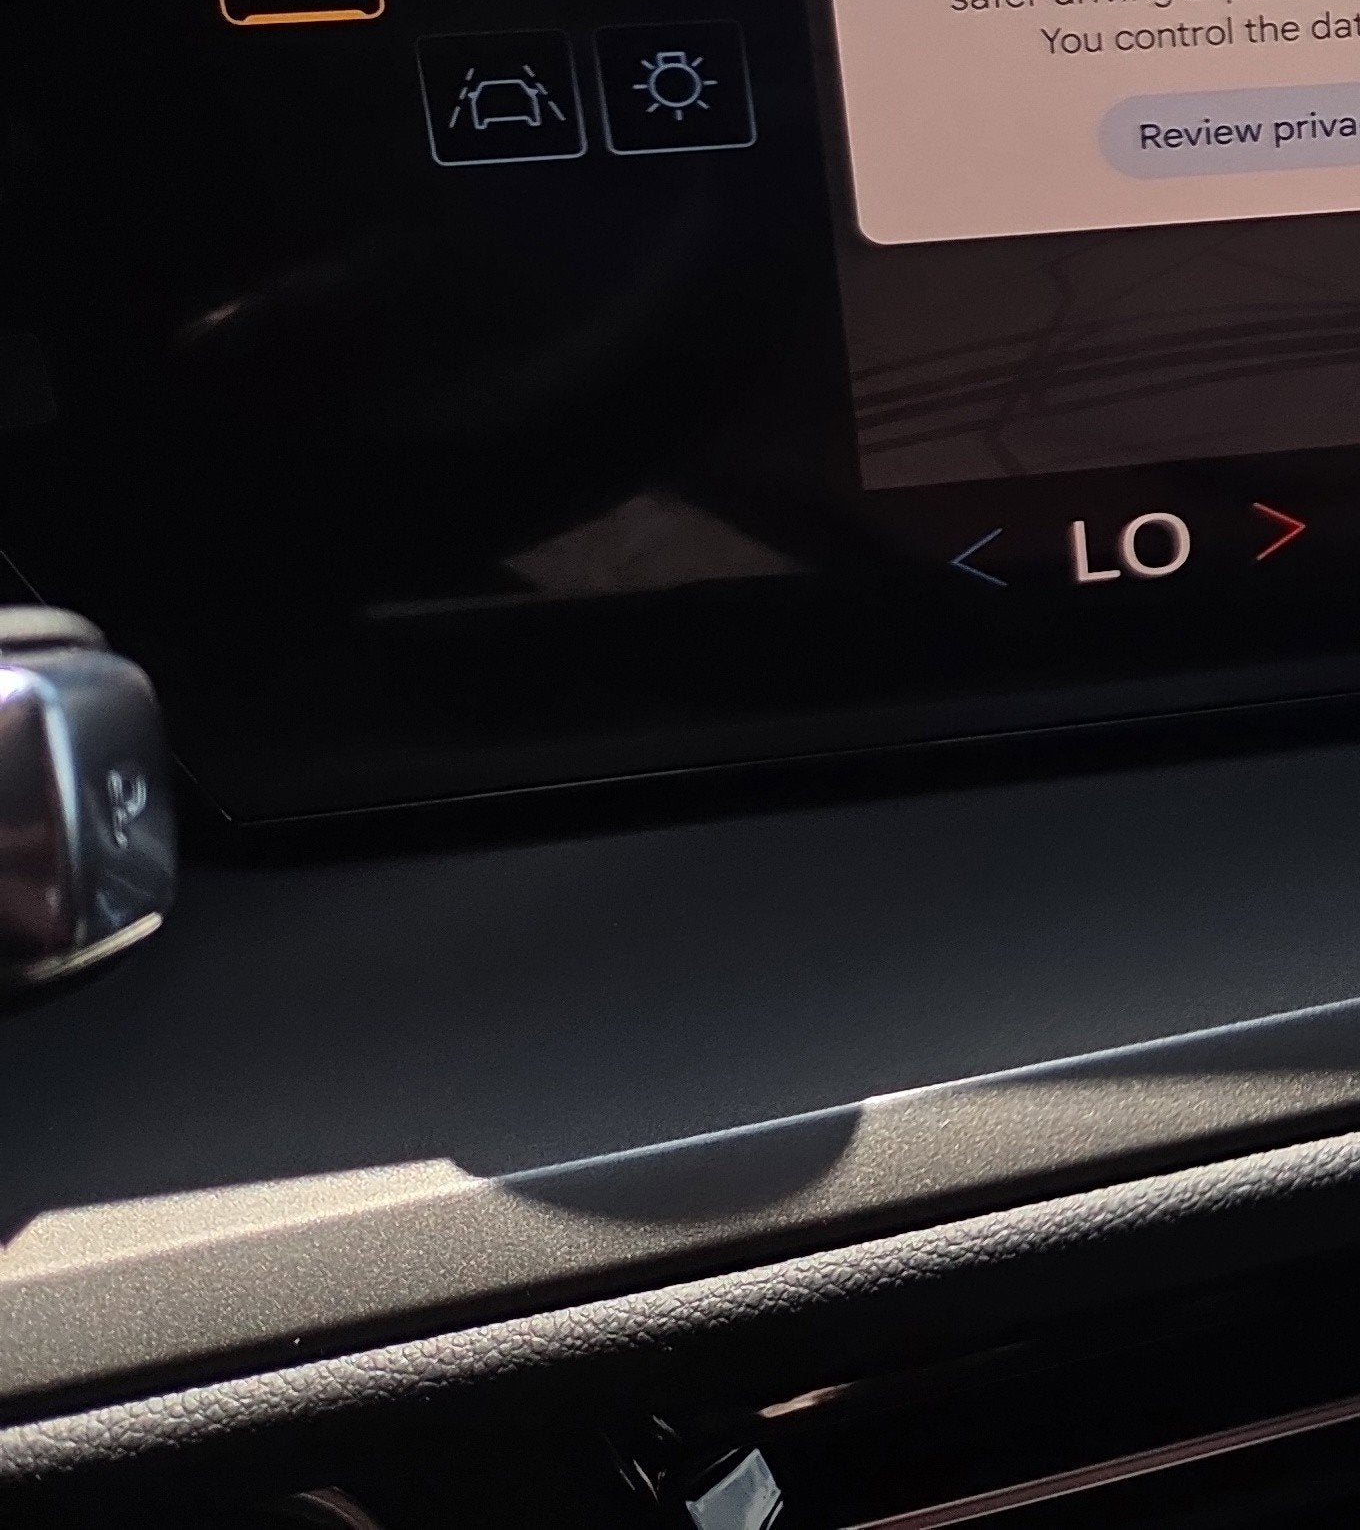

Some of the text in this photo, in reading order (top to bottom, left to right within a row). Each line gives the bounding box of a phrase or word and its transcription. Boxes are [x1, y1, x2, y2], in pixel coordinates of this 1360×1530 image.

[1040, 28, 1103, 54] You
[1114, 16, 1233, 51] control
[1243, 15, 1300, 43] the
[1139, 118, 1262, 149] Review
[1070, 512, 1191, 584] LO
